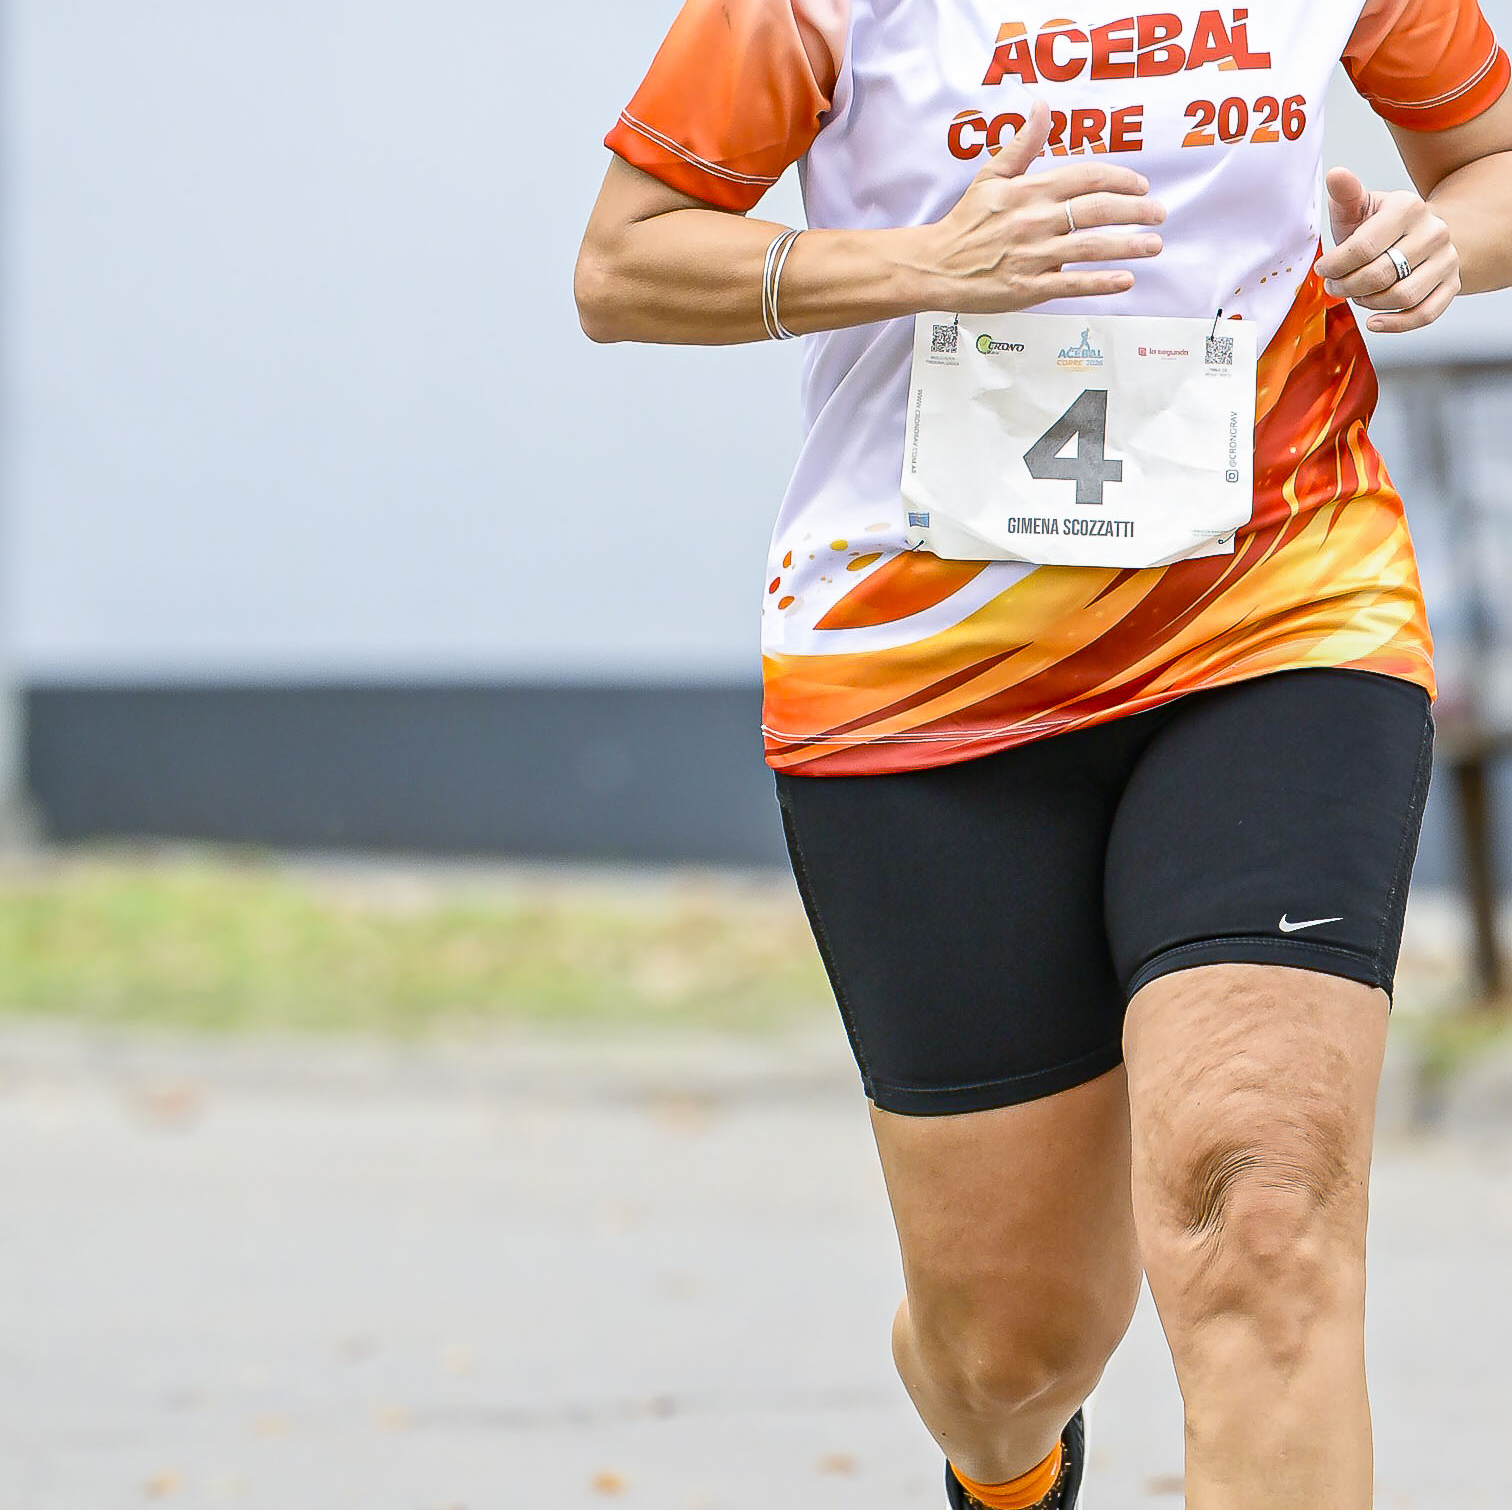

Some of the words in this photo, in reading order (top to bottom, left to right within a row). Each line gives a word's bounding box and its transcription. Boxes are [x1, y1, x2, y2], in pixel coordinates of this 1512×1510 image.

[981, 8, 1272, 86] ACEBAL
[1182, 94, 1307, 148] 2026
[1057, 348, 1104, 359] ACEBAL
[1023, 389, 1123, 505] 4
[1007, 517, 1060, 535] GIMENA
[1063, 518, 1135, 538] SCOZZATTI
